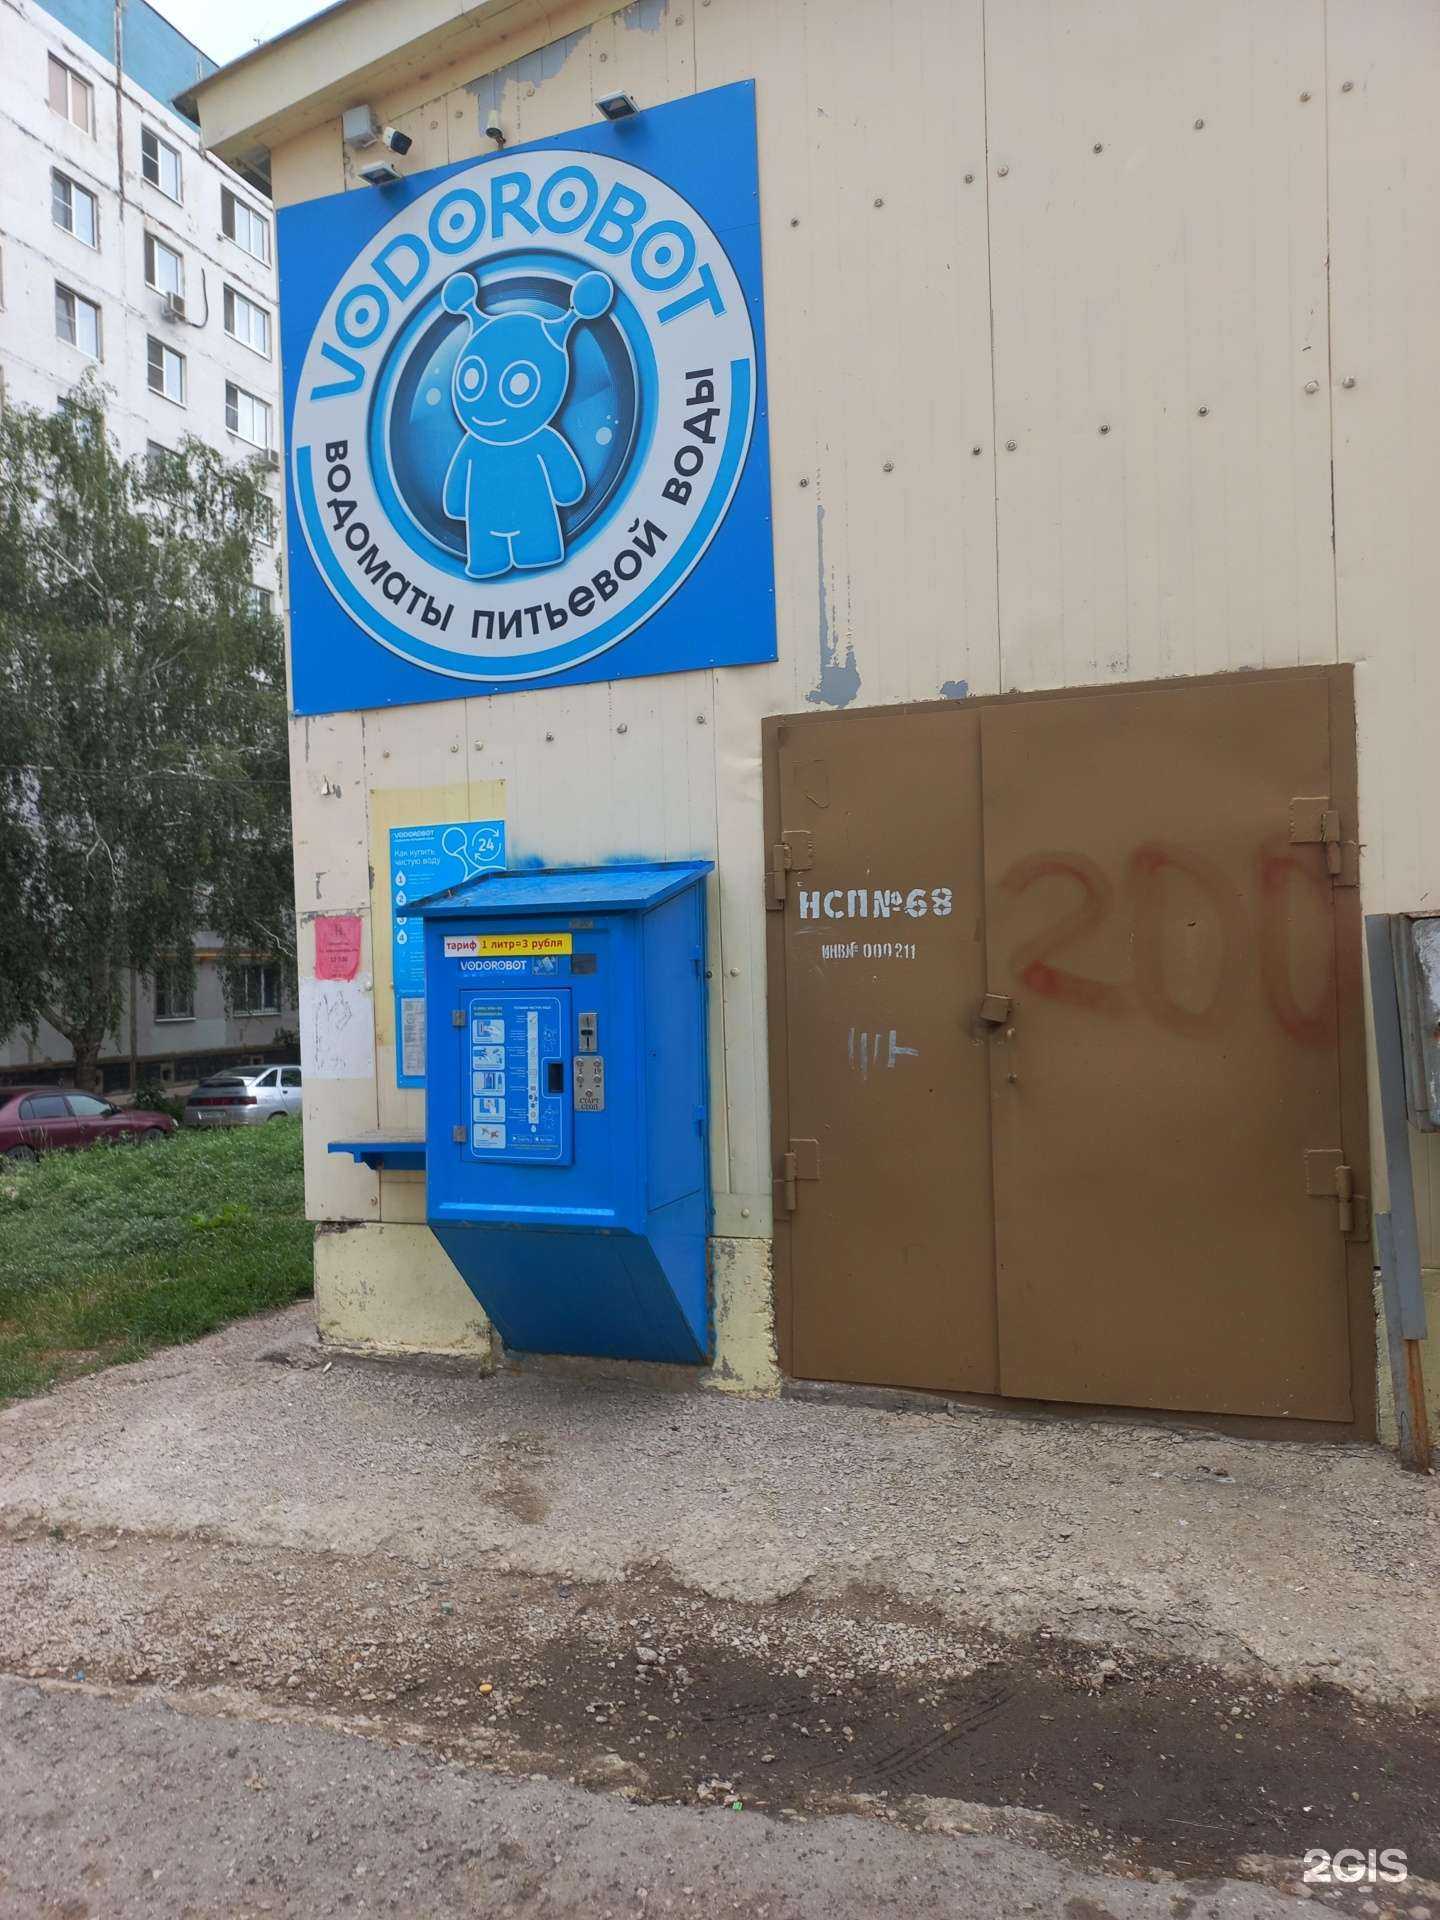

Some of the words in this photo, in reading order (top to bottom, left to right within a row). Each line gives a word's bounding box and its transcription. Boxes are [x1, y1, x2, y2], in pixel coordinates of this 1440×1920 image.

[311, 166, 727, 402] VODOROBOT
[478, 838, 494, 852] 24
[446, 940, 477, 952] тариф
[482, 940, 487, 949] 1
[531, 937, 563, 949] рубля
[1001, 838, 1361, 1047] 200
[460, 960, 528, 971] VODOROBOT
